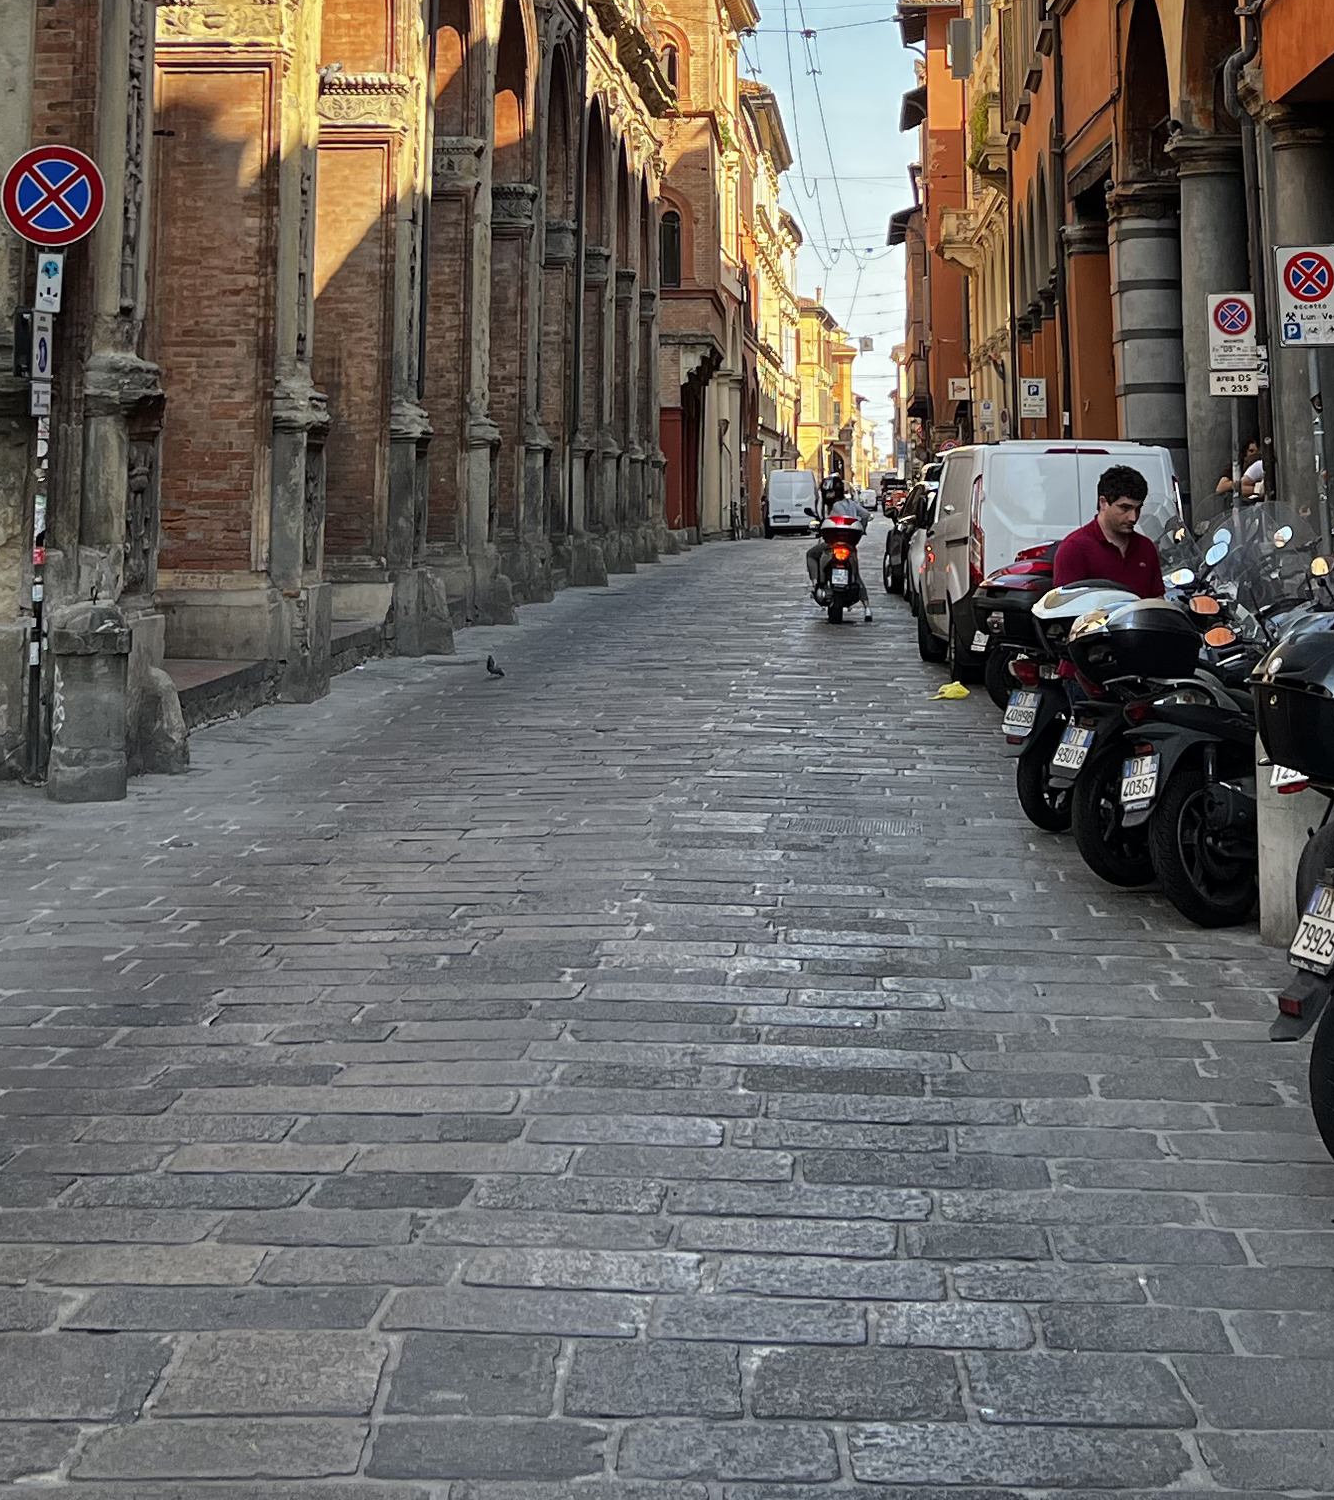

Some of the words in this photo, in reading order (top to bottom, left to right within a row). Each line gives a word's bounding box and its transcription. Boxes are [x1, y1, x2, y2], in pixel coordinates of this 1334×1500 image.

[1238, 374, 1252, 382] DS
[1232, 385, 1249, 393] 235
[1123, 777, 1155, 797] 40367
